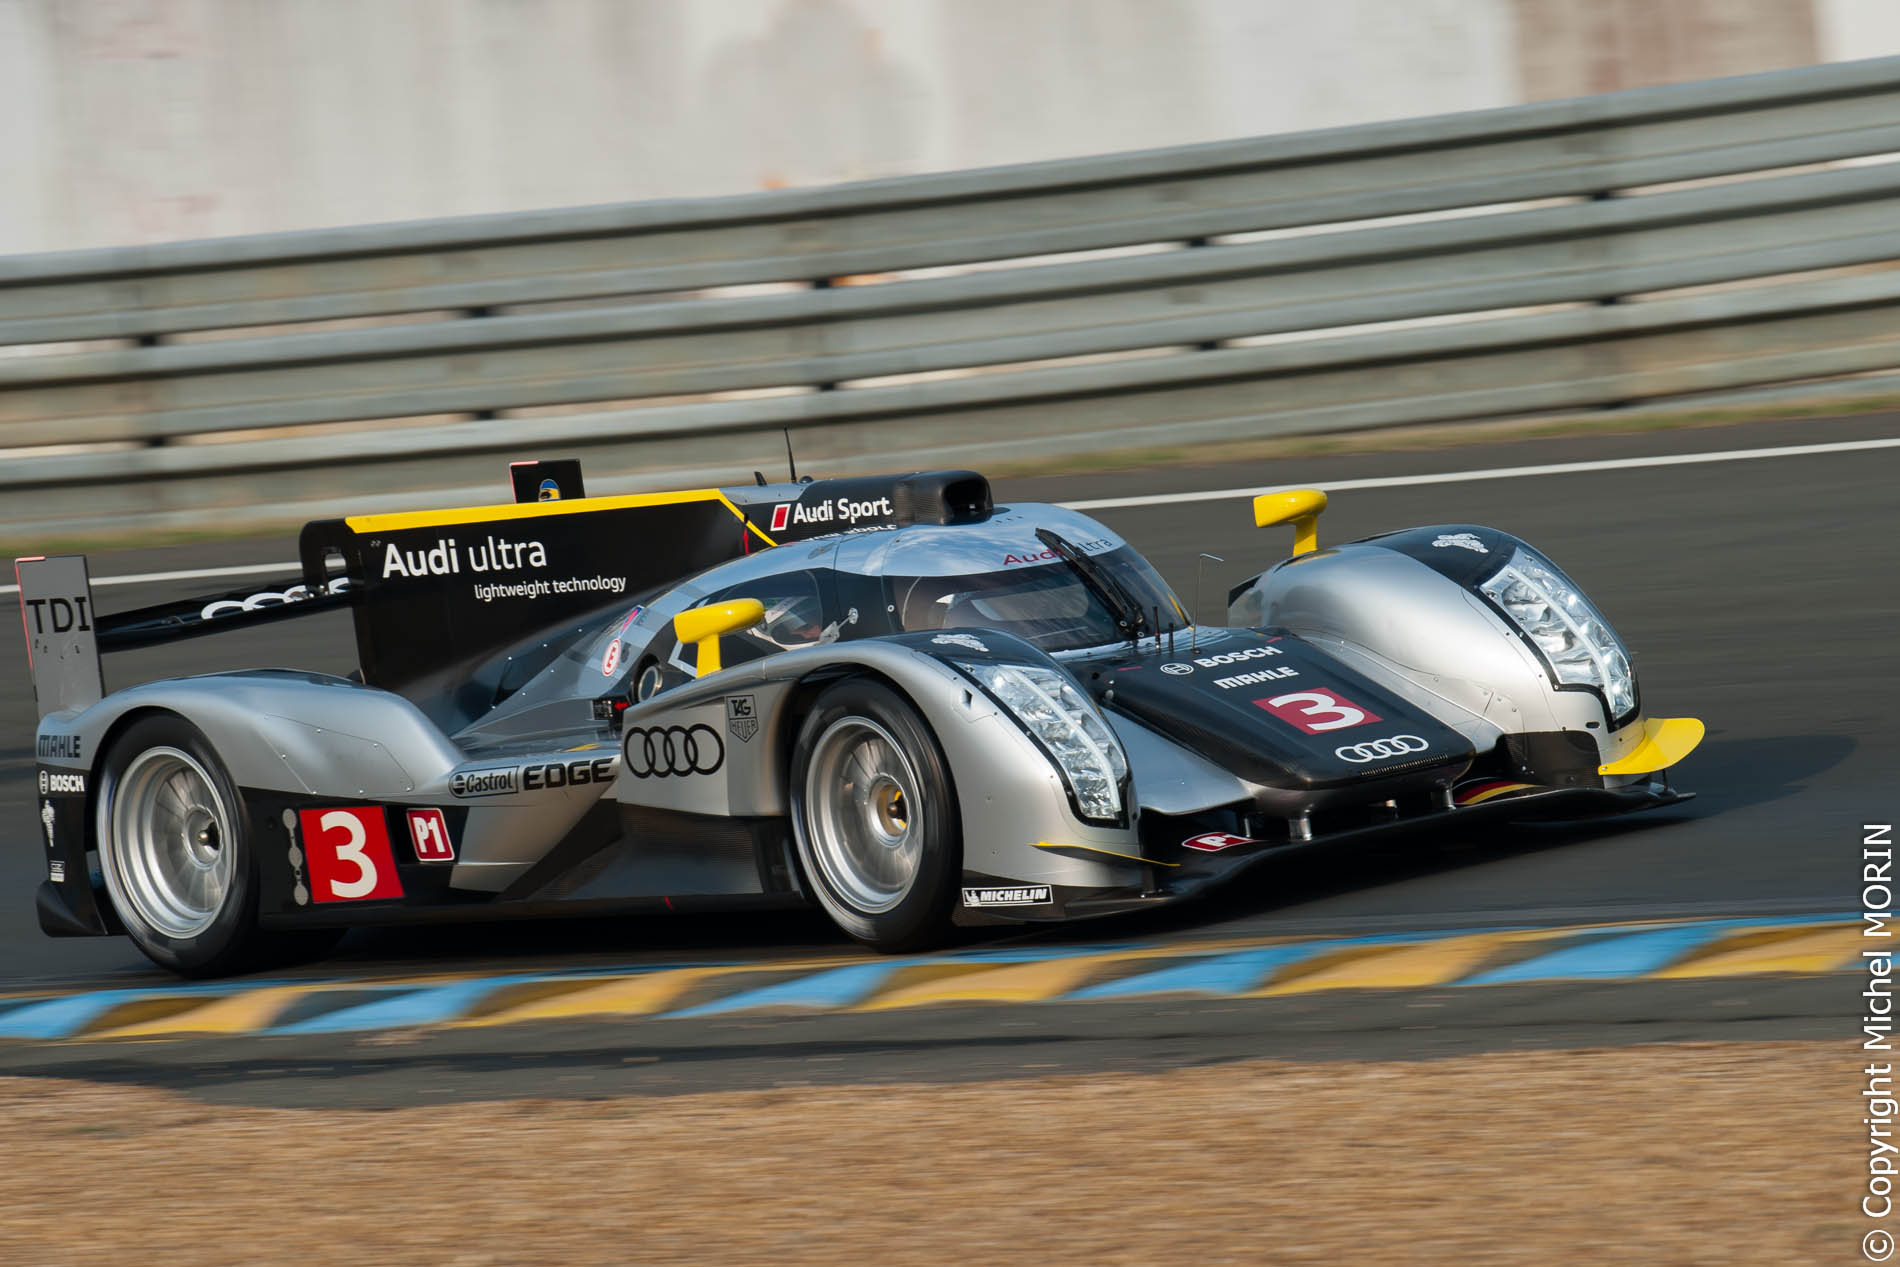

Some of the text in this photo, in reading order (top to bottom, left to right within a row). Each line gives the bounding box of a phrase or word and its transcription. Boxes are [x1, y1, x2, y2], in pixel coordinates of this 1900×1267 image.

[793, 497, 893, 524] Audi Sport
[383, 536, 547, 578] Audi ultra
[1003, 538, 1113, 565] Aud ltra
[475, 575, 626, 602] lightweight technology
[26, 596, 90, 634] TDI
[1194, 646, 1284, 668] BOSCH
[1213, 666, 1300, 689] MAHLE
[1268, 692, 1365, 731] 3
[38, 735, 81, 758] MAHLE
[50, 774, 85, 792] BOSCH
[466, 757, 617, 793] Castrol EDGE
[413, 817, 446, 853] P1
[320, 811, 378, 898] 3
[980, 888, 1048, 902] MICHELIN
